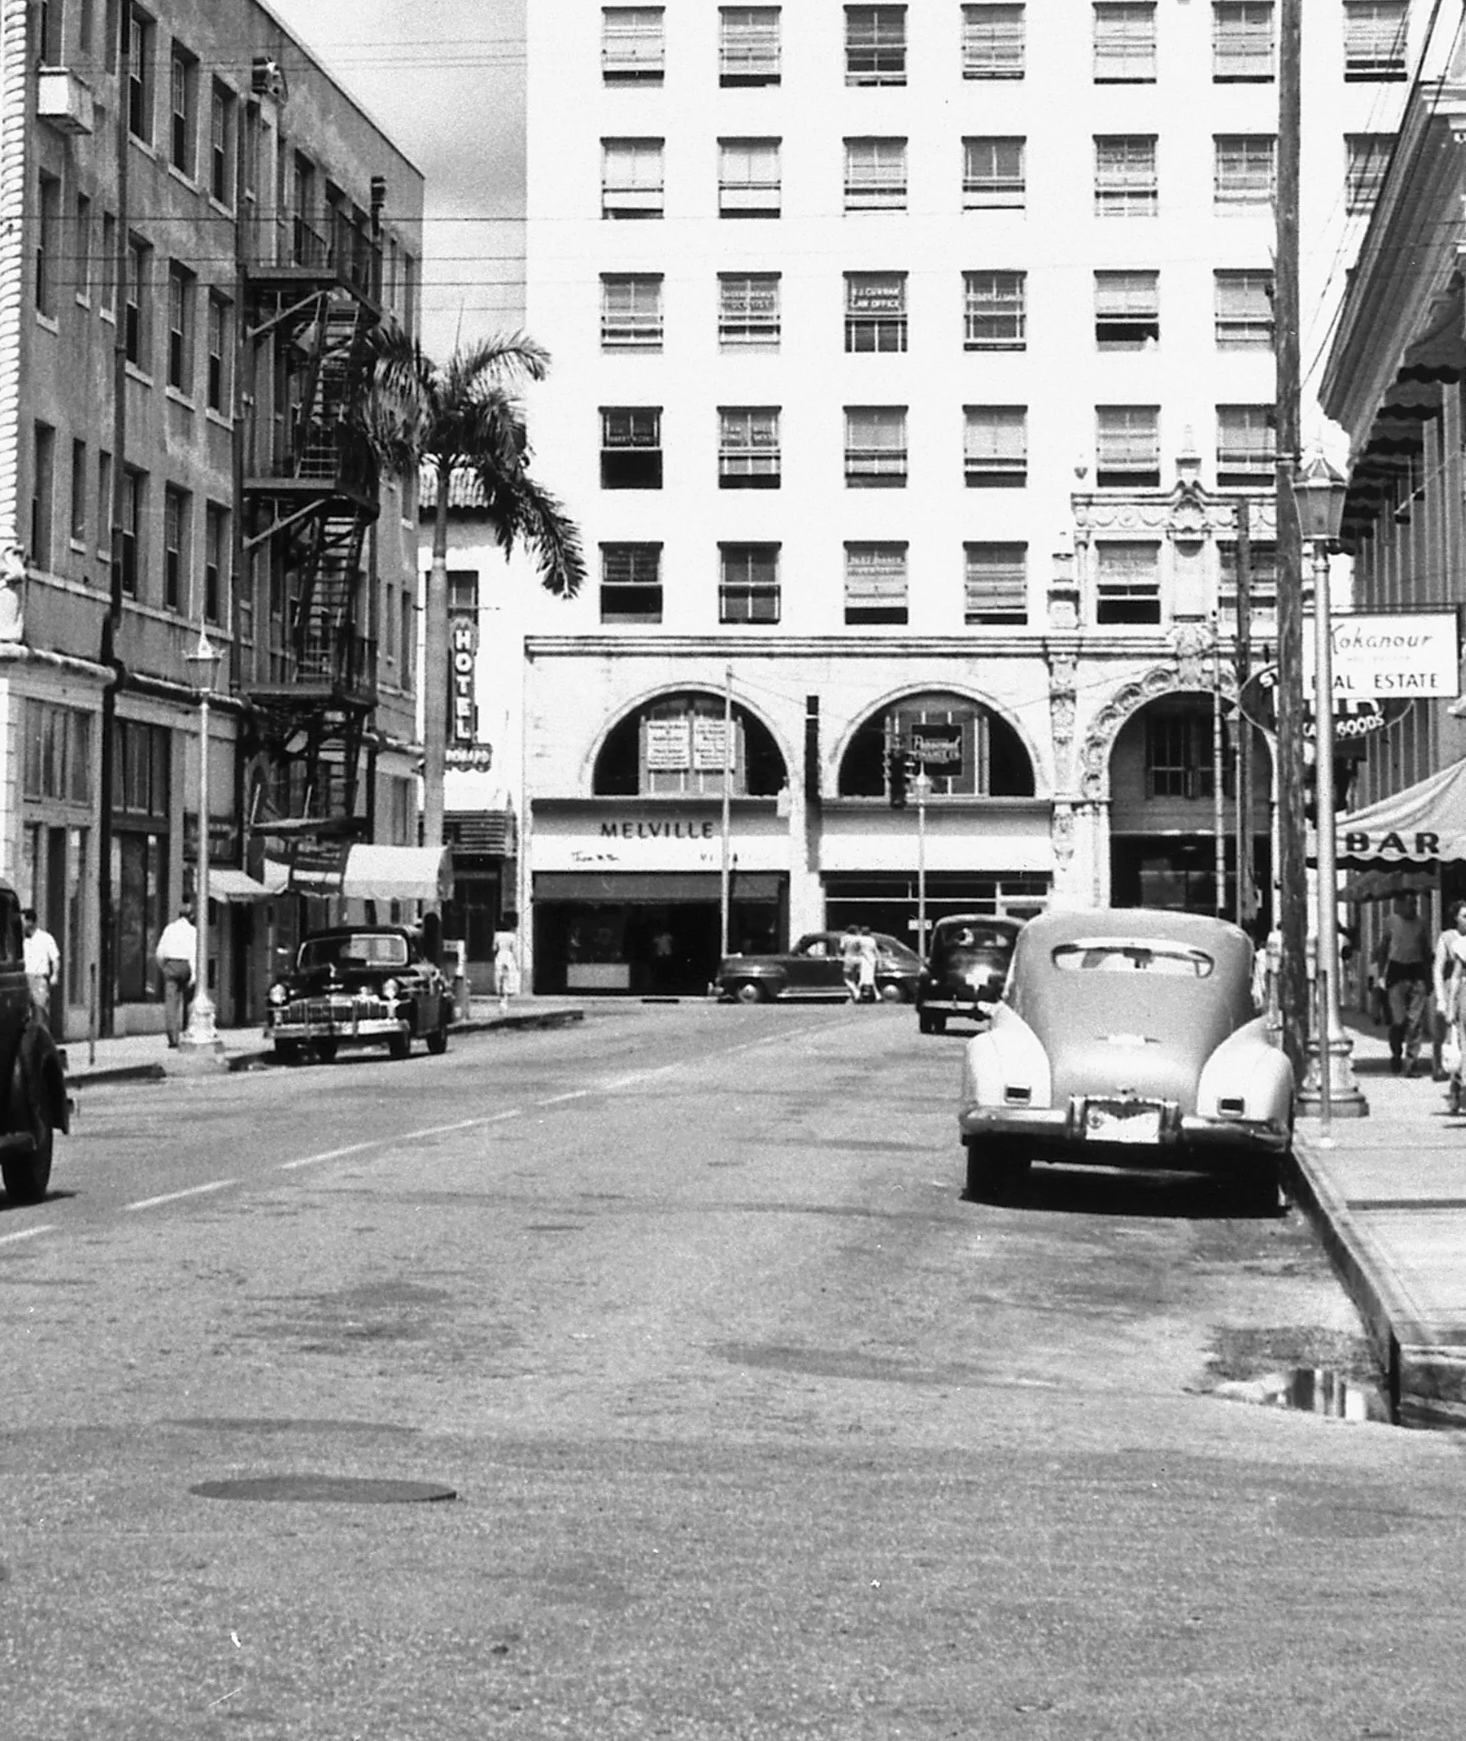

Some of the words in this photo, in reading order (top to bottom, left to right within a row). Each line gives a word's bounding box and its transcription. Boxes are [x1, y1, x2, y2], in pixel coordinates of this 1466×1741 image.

[455, 629, 473, 739] HOTEL
[1374, 673, 1439, 690] ESTATE
[1336, 712, 1384, 736] GOODS
[600, 822, 714, 839] MELVILLE
[1344, 832, 1441, 855] BAR
